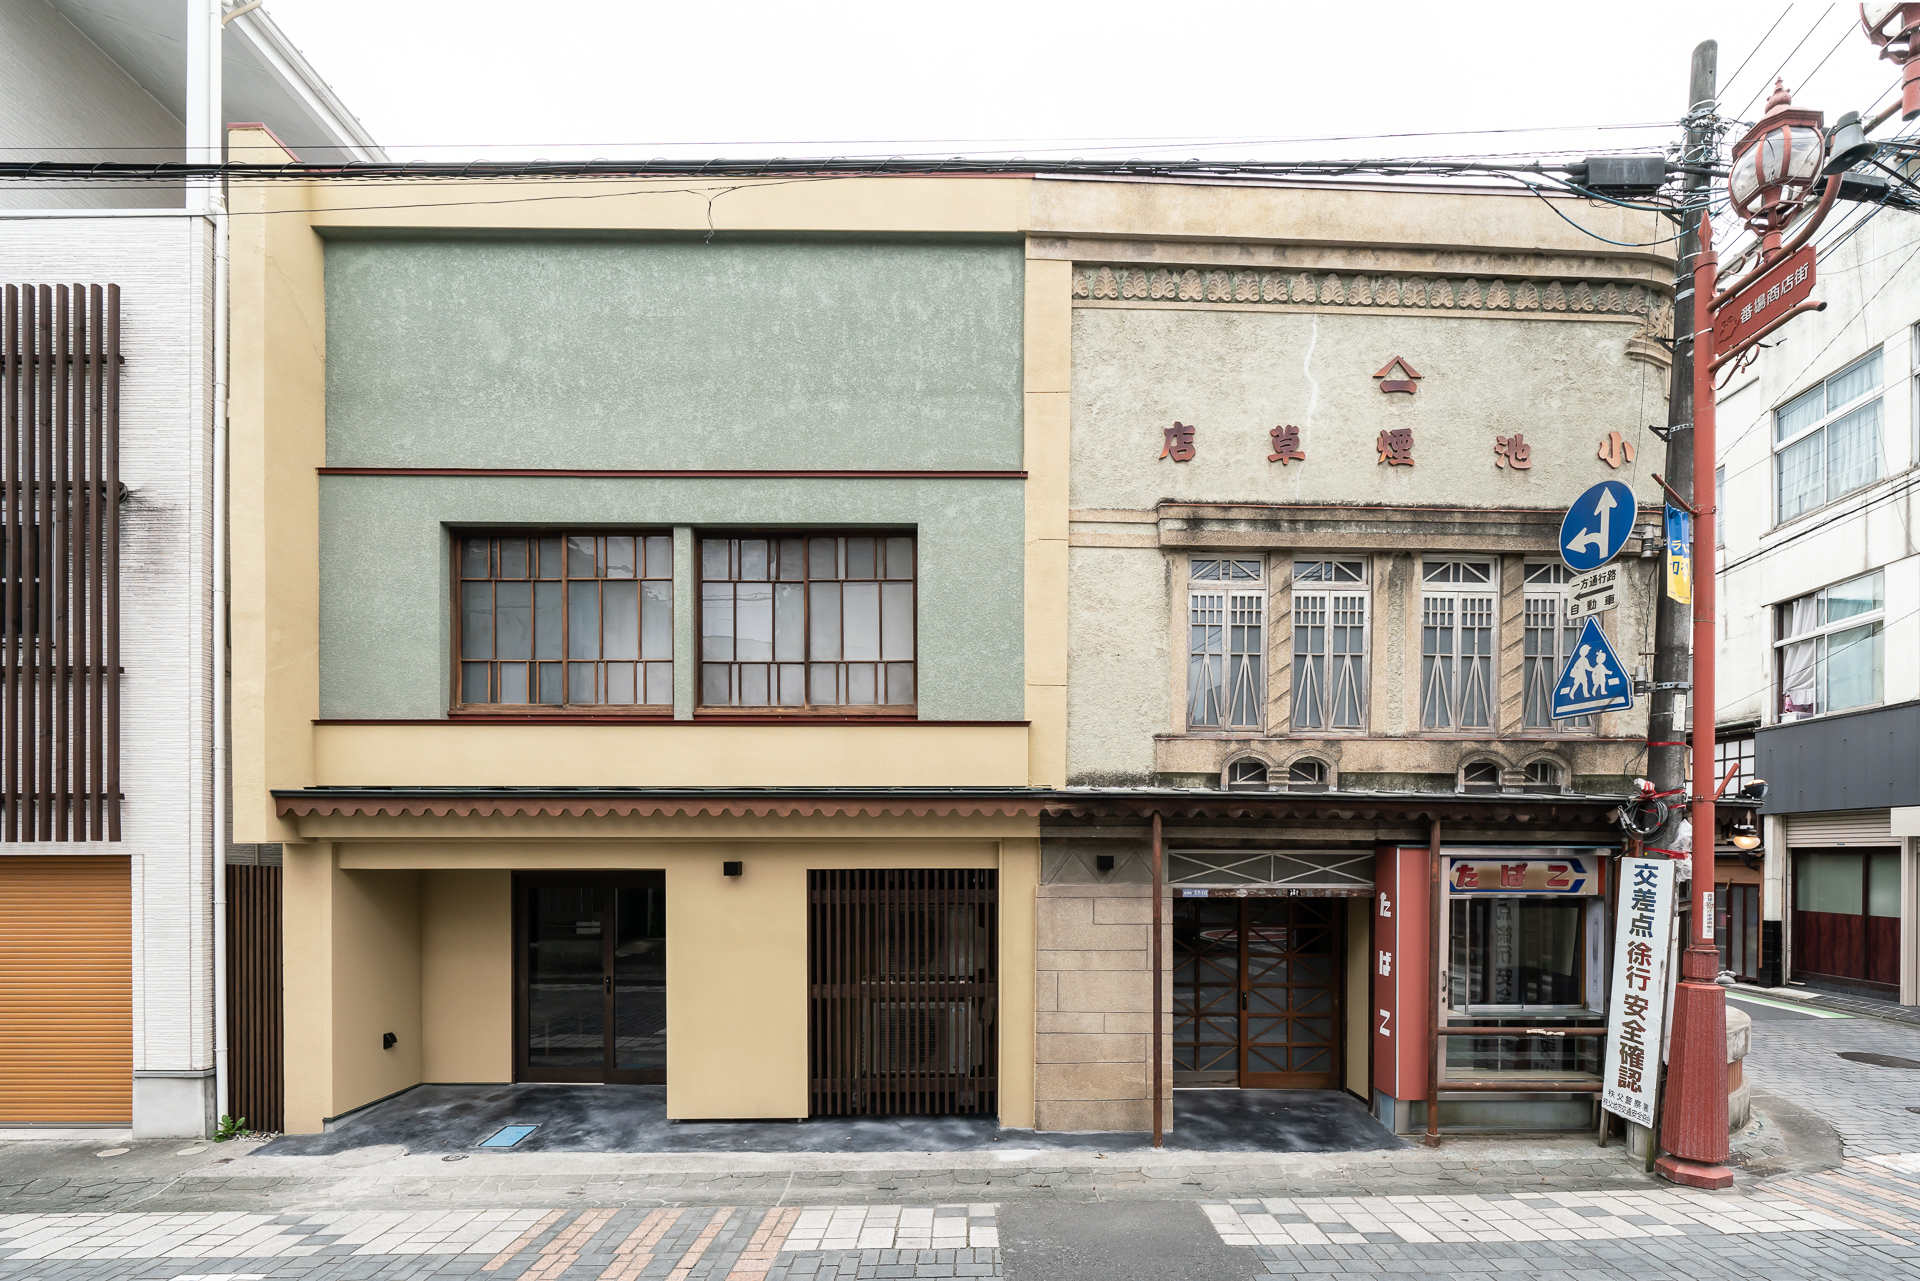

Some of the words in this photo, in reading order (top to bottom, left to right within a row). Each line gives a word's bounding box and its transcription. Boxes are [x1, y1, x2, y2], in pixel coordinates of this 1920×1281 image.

[1740, 262, 1809, 324] 番場商店街
[1572, 569, 1617, 590] 一方通行路
[1571, 594, 1616, 616] 自動車
[1456, 863, 1570, 888] たばこ
[1379, 892, 1392, 1037] たばこ
